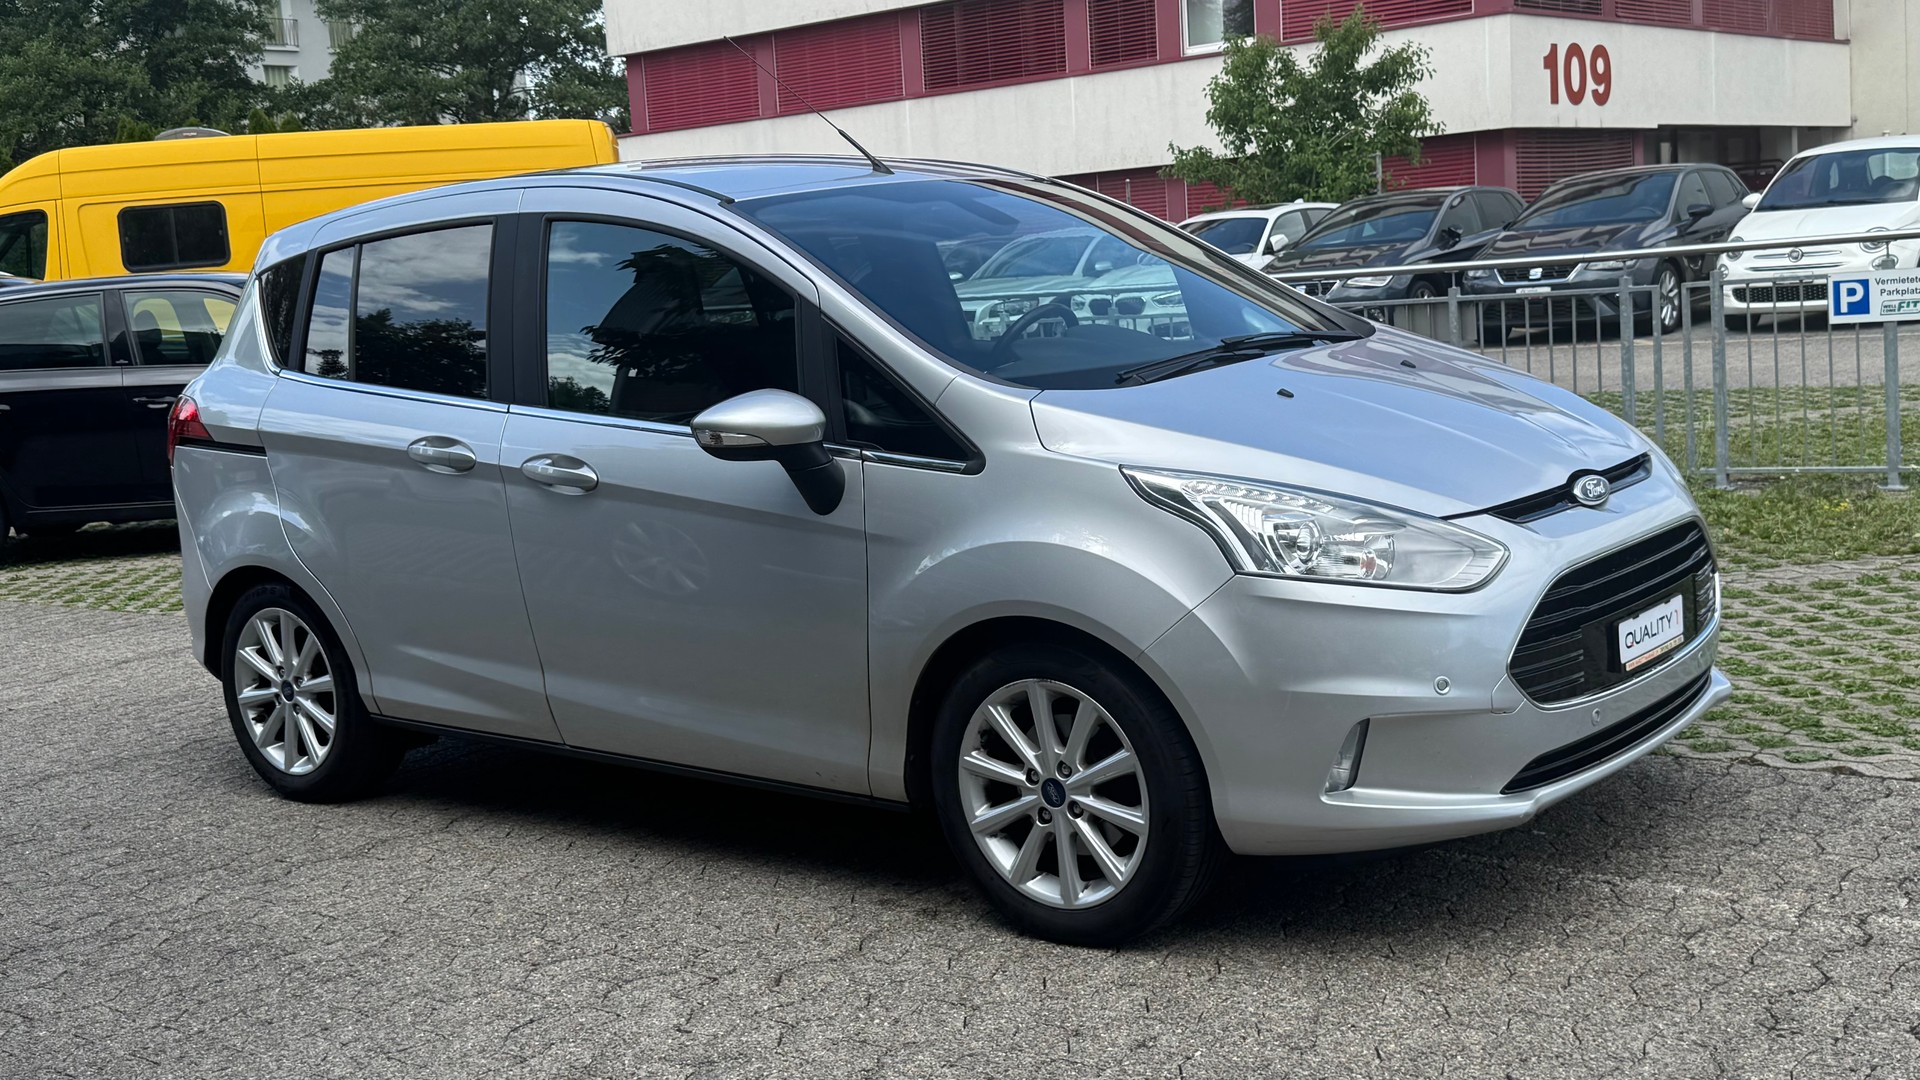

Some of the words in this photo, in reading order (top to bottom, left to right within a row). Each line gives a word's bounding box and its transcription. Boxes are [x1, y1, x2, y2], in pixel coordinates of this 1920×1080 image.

[1543, 42, 1611, 106] 109
[1840, 282, 1864, 313] P
[1585, 480, 1605, 497] Ford
